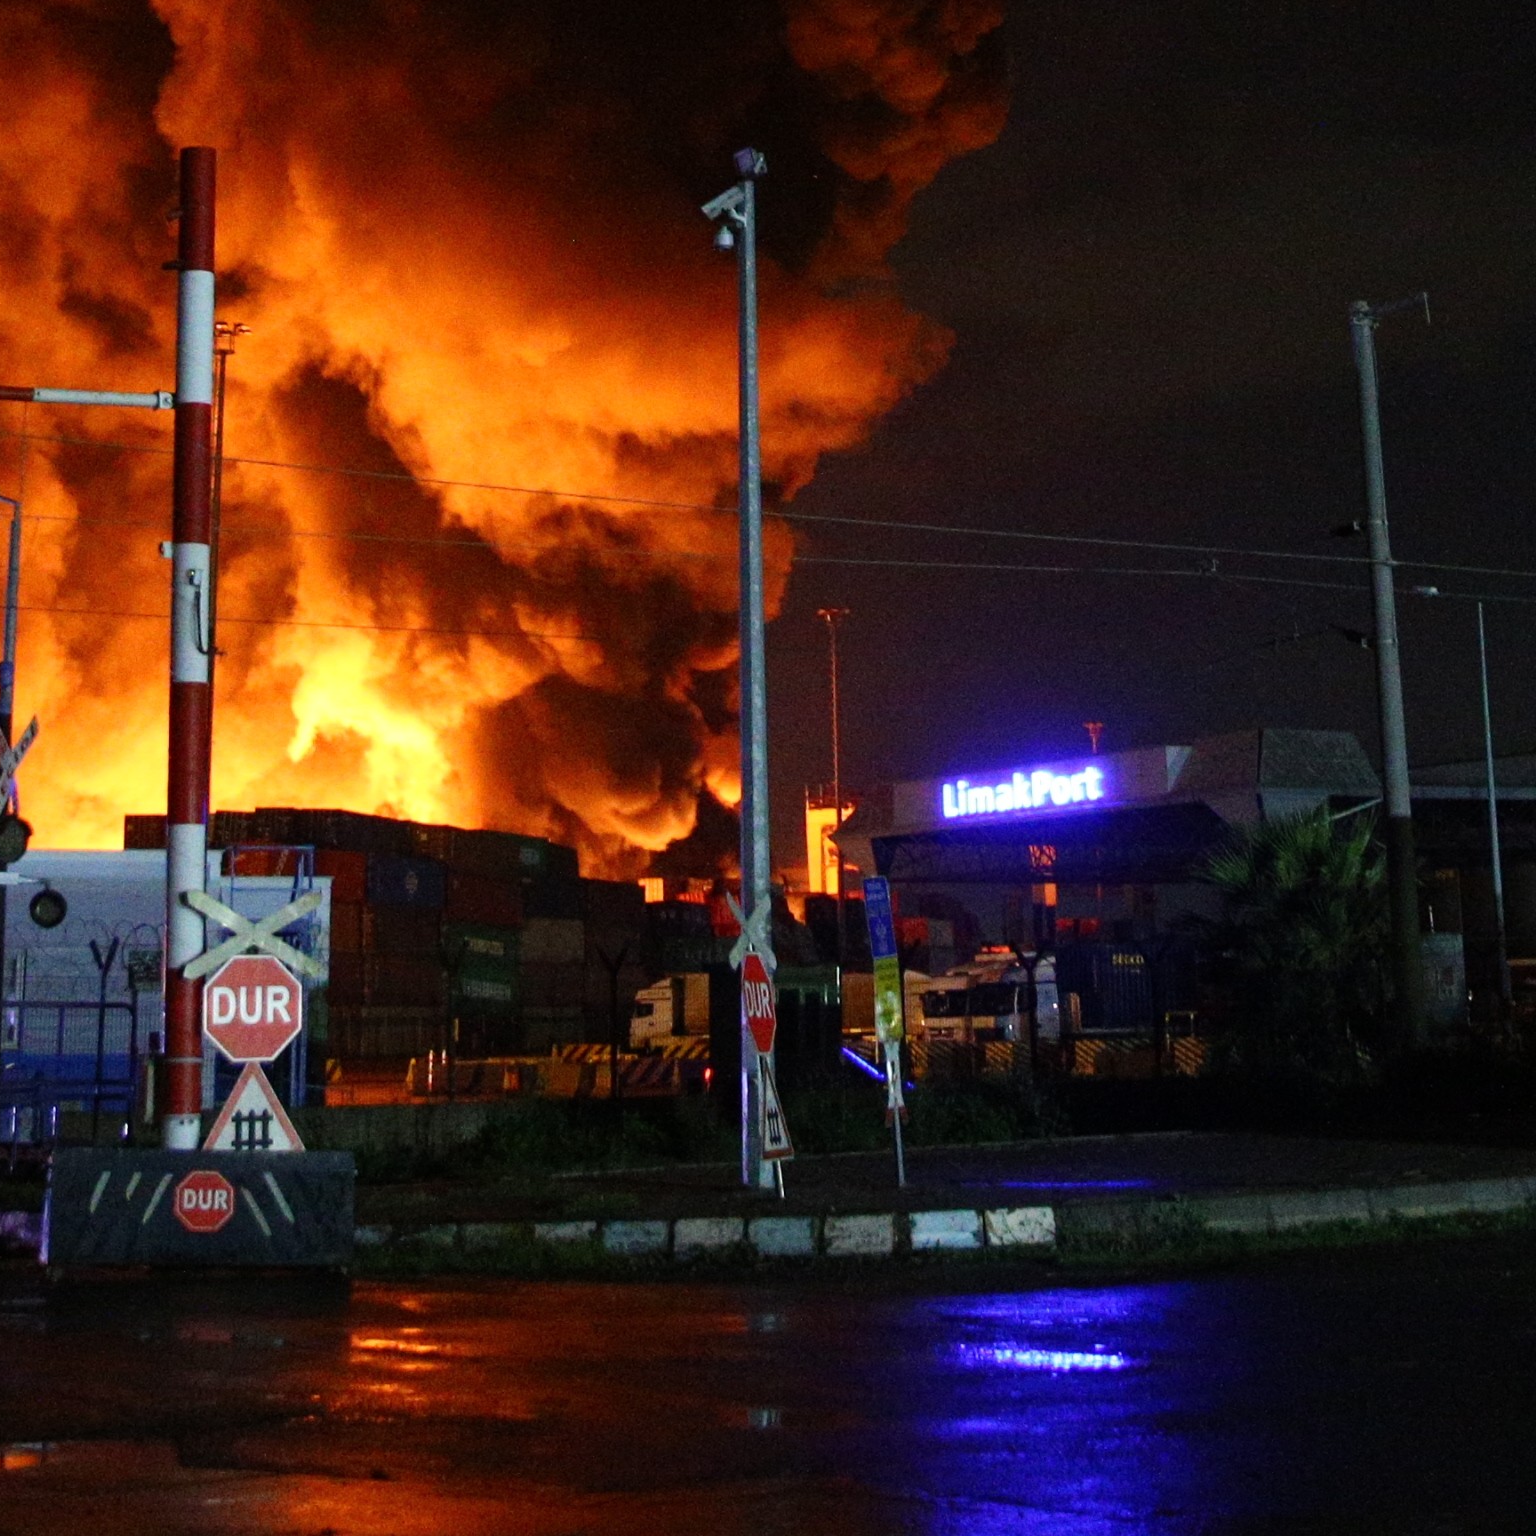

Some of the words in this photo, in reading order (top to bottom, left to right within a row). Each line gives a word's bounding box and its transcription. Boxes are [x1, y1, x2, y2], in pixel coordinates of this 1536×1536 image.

[942, 766, 1105, 818] LimakPort
[212, 985, 291, 1026] DUR
[743, 981, 774, 1019] DUR
[182, 1187, 229, 1211] DUR
